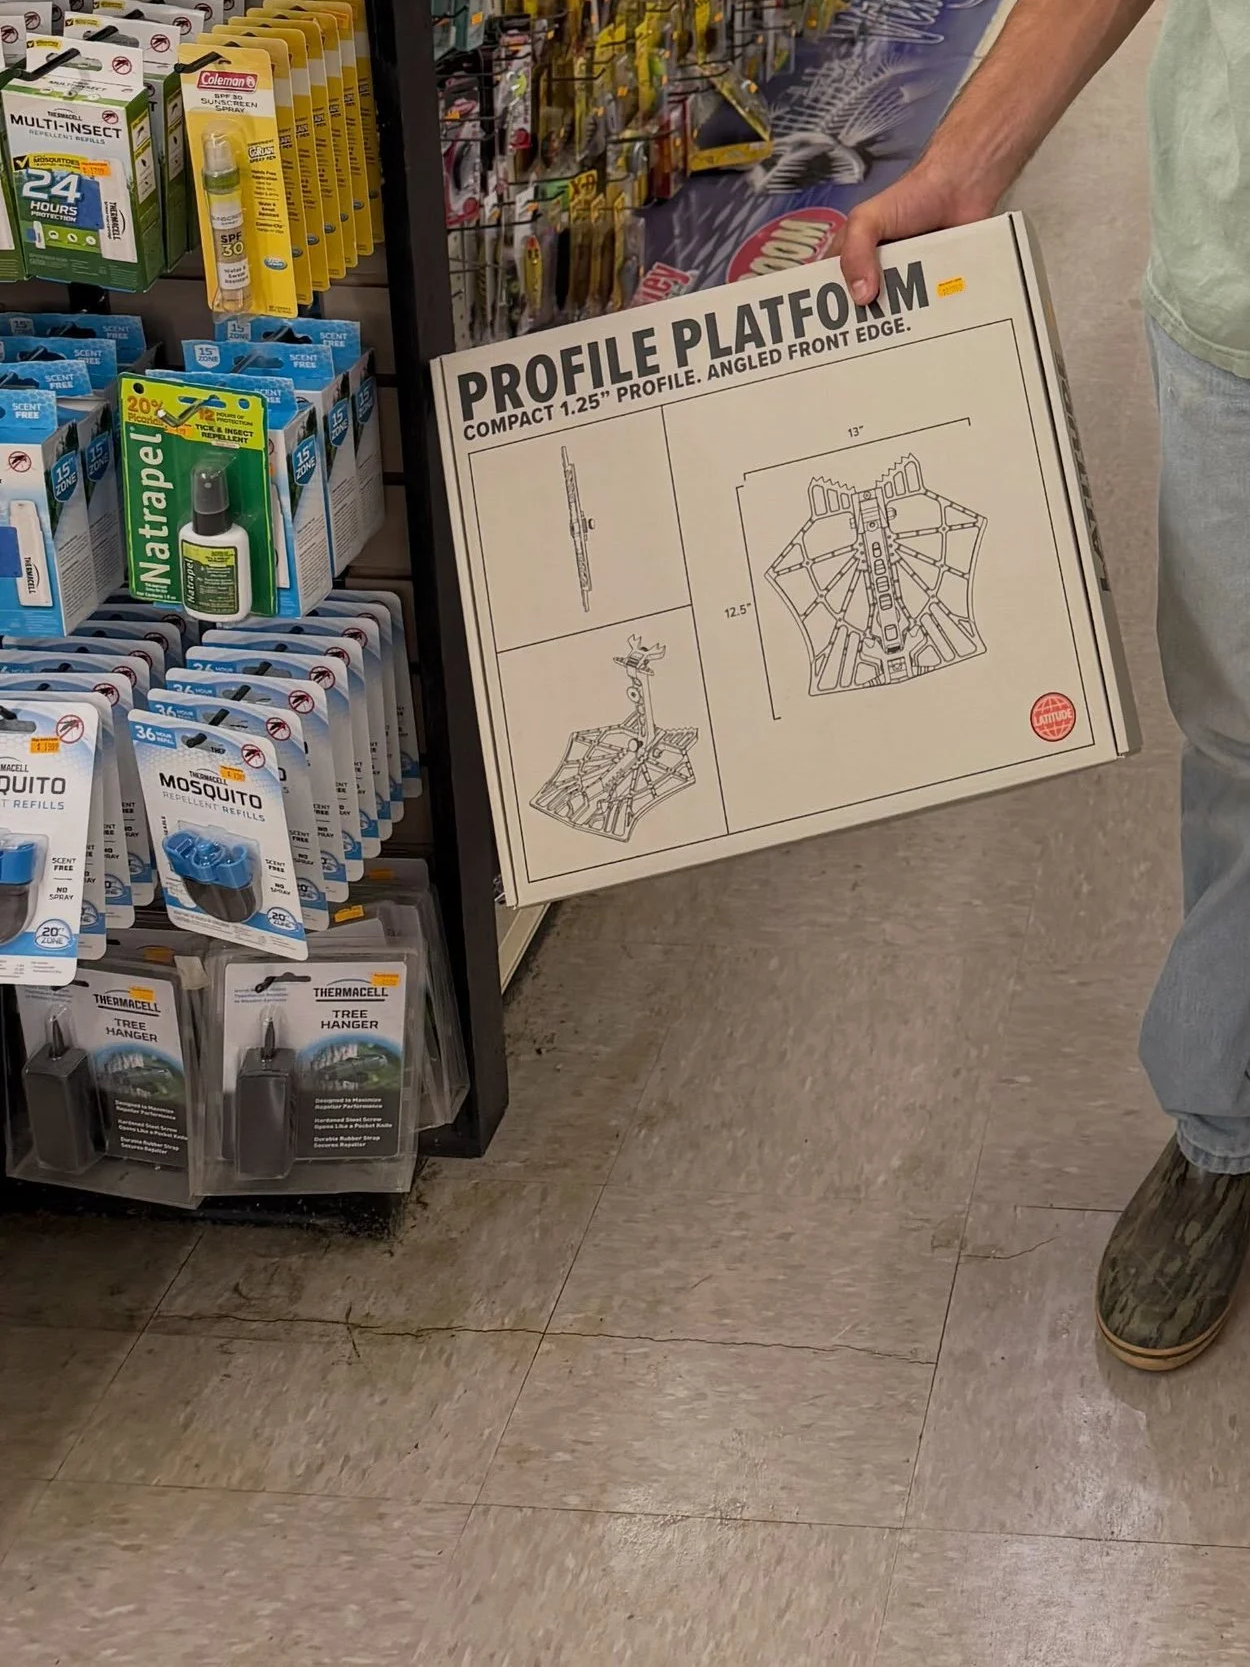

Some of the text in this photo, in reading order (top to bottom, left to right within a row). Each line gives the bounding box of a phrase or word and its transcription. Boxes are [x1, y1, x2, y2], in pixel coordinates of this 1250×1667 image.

[201, 72, 245, 88] Coleman
[201, 97, 258, 108] SUNSCREEN
[215, 105, 246, 113] SPRAY
[48, 111, 83, 121] THERMACELL
[10, 114, 122, 139] MULTI-INSECT
[29, 129, 105, 145] REPELLENT REFILLS
[22, 168, 81, 204] 24
[30, 200, 78, 215] HOURS
[31, 211, 77, 222] PROTECTION
[221, 231, 242, 243] SPF
[222, 241, 244, 257] 30
[103, 325, 129, 333] SCENT
[107, 332, 128, 340] FREE
[320, 332, 348, 340] SCENT
[74, 349, 102, 358] SCENT
[199, 347, 212, 356] 15
[290, 354, 317, 362] SCENT
[293, 361, 317, 369] FREE
[45, 374, 74, 383] SCENT
[457, 327, 660, 422] PROFILE
[463, 404, 554, 441] COMPACT
[617, 369, 701, 403] PROFILE.
[707, 348, 782, 381] ANGLED
[789, 330, 849, 362] FRONT
[856, 317, 911, 344] EDGE.
[12, 403, 42, 411] SCENT
[127, 396, 163, 415] 20%
[15, 411, 40, 419] FREE
[216, 417, 253, 426] PROTECTION
[333, 410, 343, 426] 15
[196, 423, 216, 432] TICK
[225, 428, 254, 437] INSECT
[331, 420, 348, 440] ZONE
[848, 426, 864, 438] 13"
[202, 433, 249, 444] REPELLENT
[91, 444, 103, 461] 15
[297, 446, 310, 467] 15
[56, 461, 71, 482] 15
[89, 454, 109, 476] ZONE
[295, 456, 315, 480] ZONE
[56, 472, 77, 496] ZONE
[130, 434, 174, 586] Natrapel
[24, 556, 36, 595] THERMACELL
[186, 559, 196, 604] Natrapel
[724, 603, 752, 619] 12.5"
[155, 704, 177, 718] 36
[1033, 706, 1074, 727] LATITUDE
[135, 725, 156, 742] 36
[156, 731, 172, 739] HOUR
[157, 737, 175, 745] REFILL
[189, 770, 228, 785] THERMACELL
[159, 772, 263, 810] MOSQUITO
[13, 799, 65, 810] REFILLS
[162, 791, 266, 822] REPELLENT REFILLS
[265, 858, 286, 867] SCENT
[268, 865, 285, 873] FREE
[270, 887, 291, 896] SPRAY
[313, 987, 388, 997] THERMACELL
[93, 993, 162, 1013] THERMACELL
[332, 1010, 368, 1019] TREE
[114, 1017, 146, 1031] TREE
[321, 1020, 378, 1029] HANGER
[106, 1026, 158, 1043] HANGER
